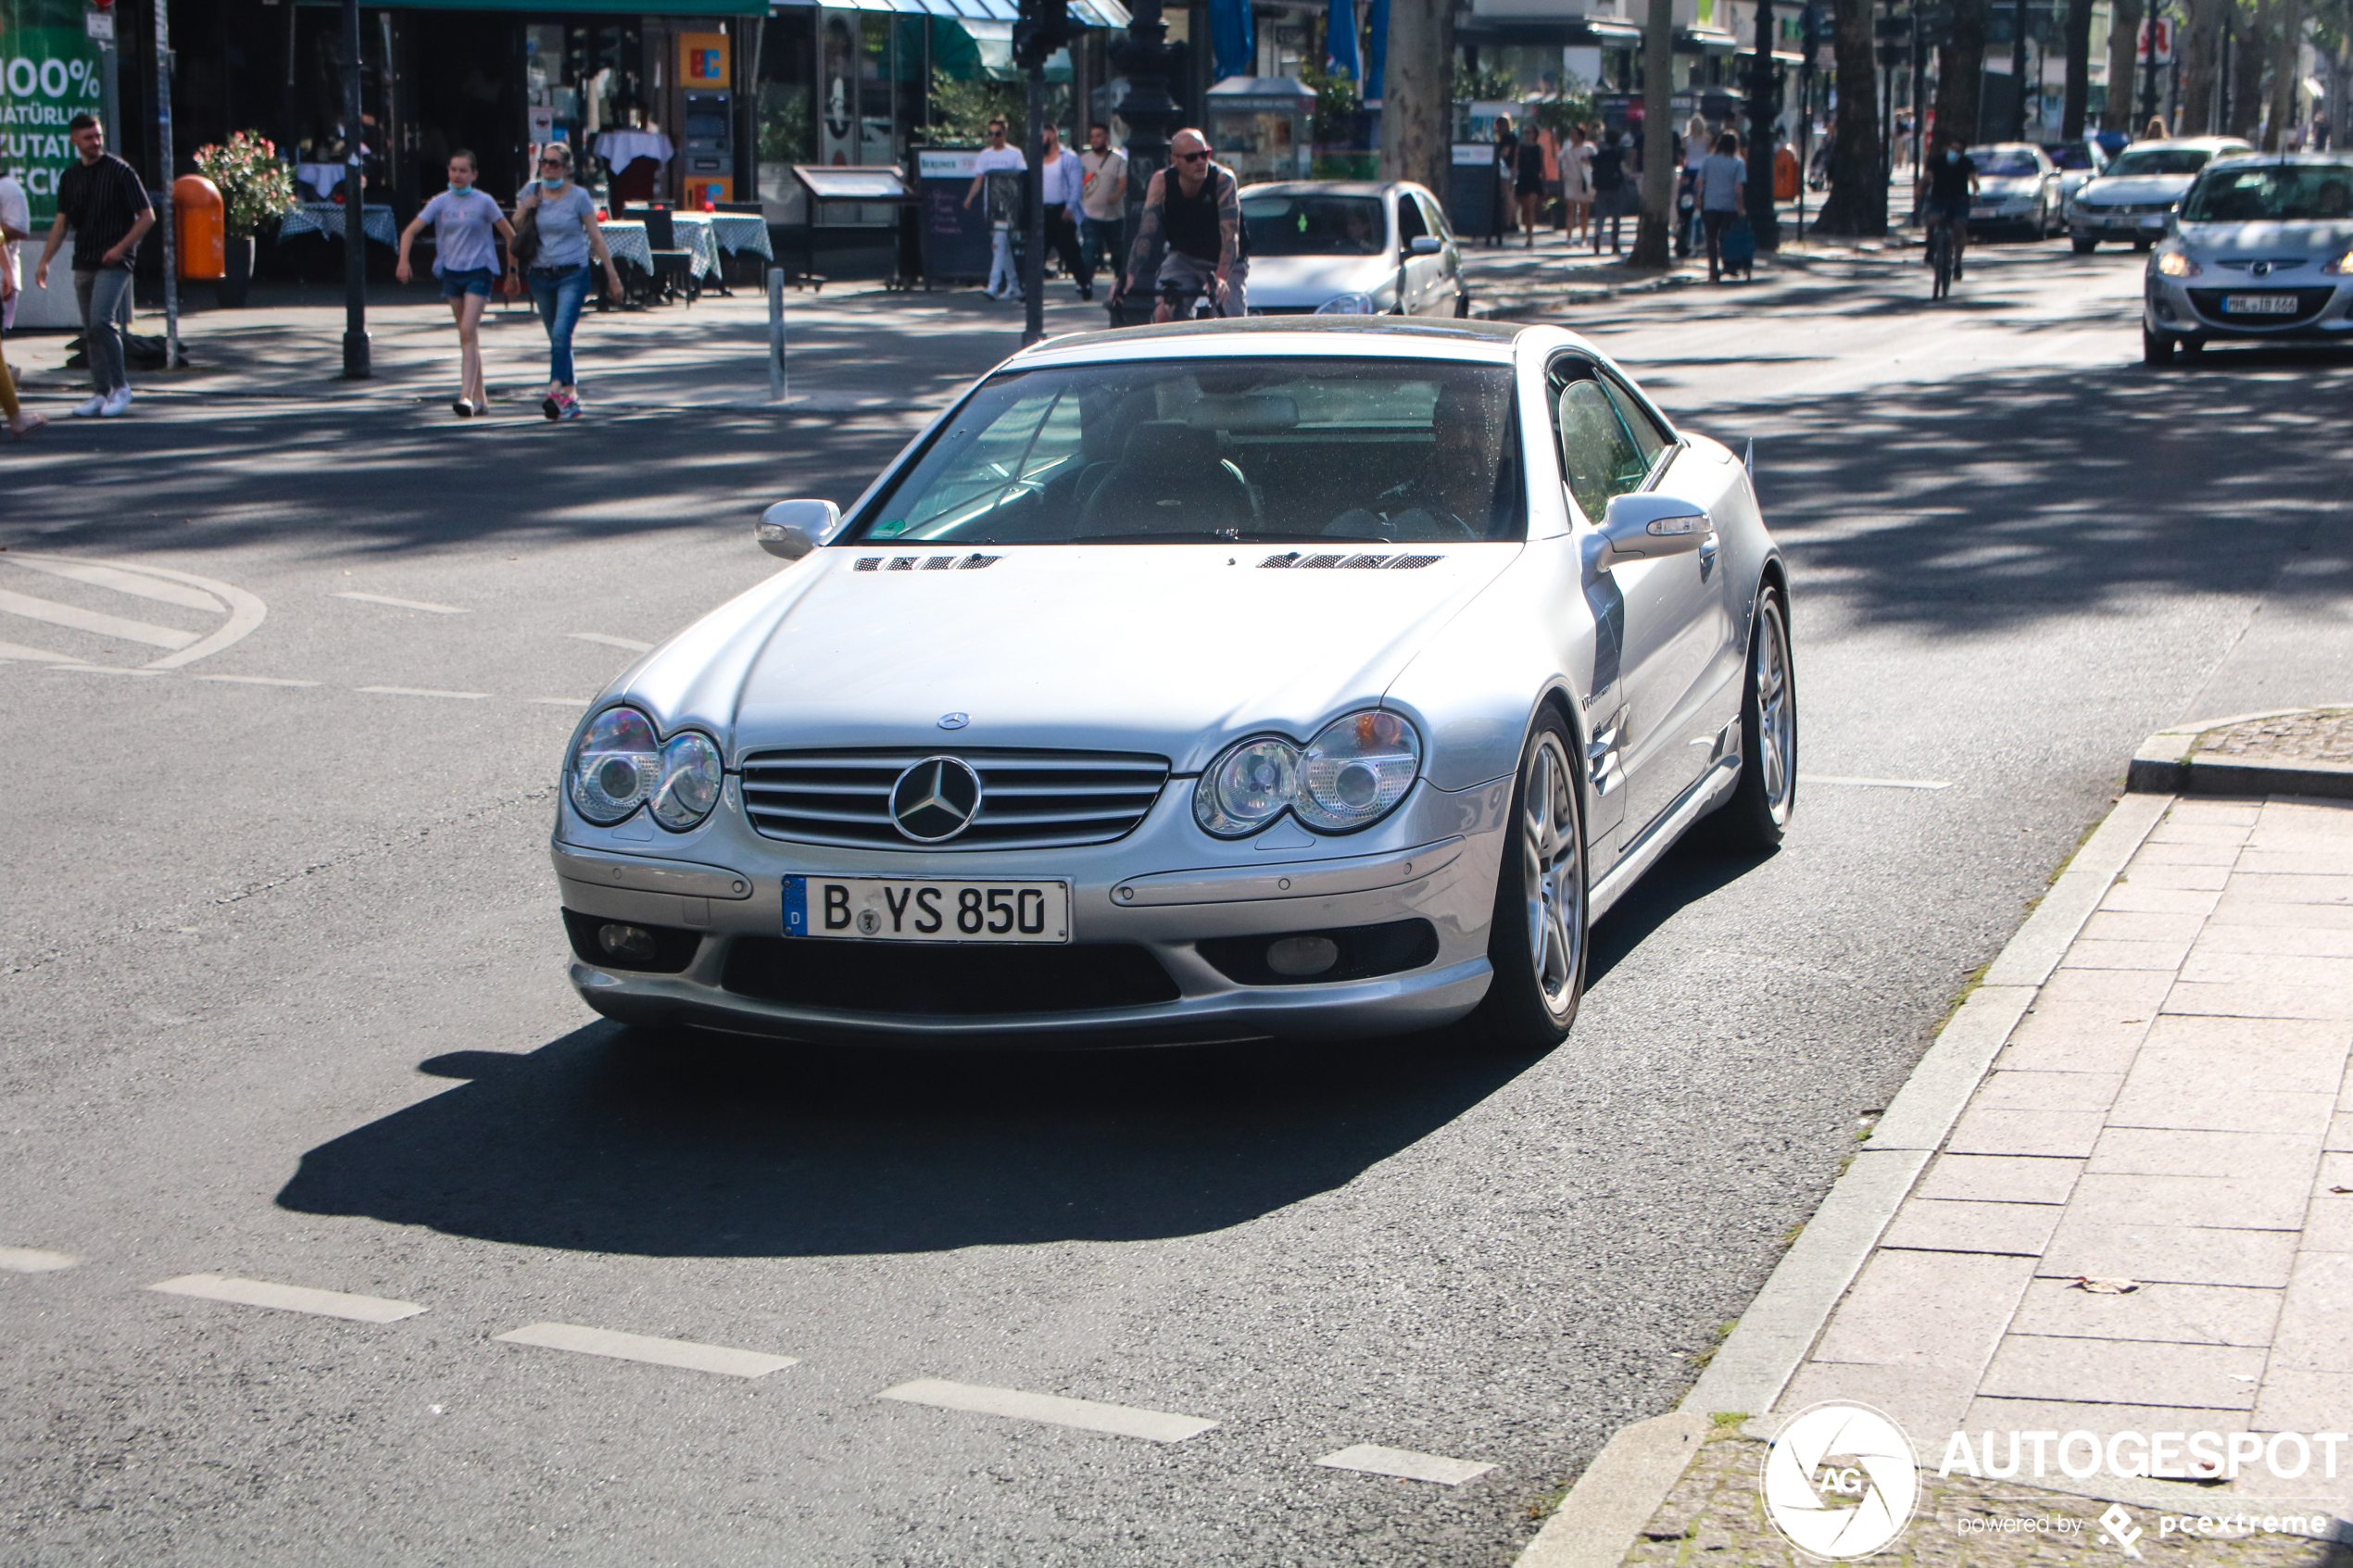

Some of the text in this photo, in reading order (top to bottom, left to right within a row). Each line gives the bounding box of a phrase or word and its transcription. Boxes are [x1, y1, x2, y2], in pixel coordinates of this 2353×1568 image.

[690, 49, 720, 78] EC
[0, 102, 100, 125] ATÜRLI
[0, 133, 82, 158] ZUTAT
[790, 911, 800, 924] D
[824, 884, 1045, 935] B YS 850
